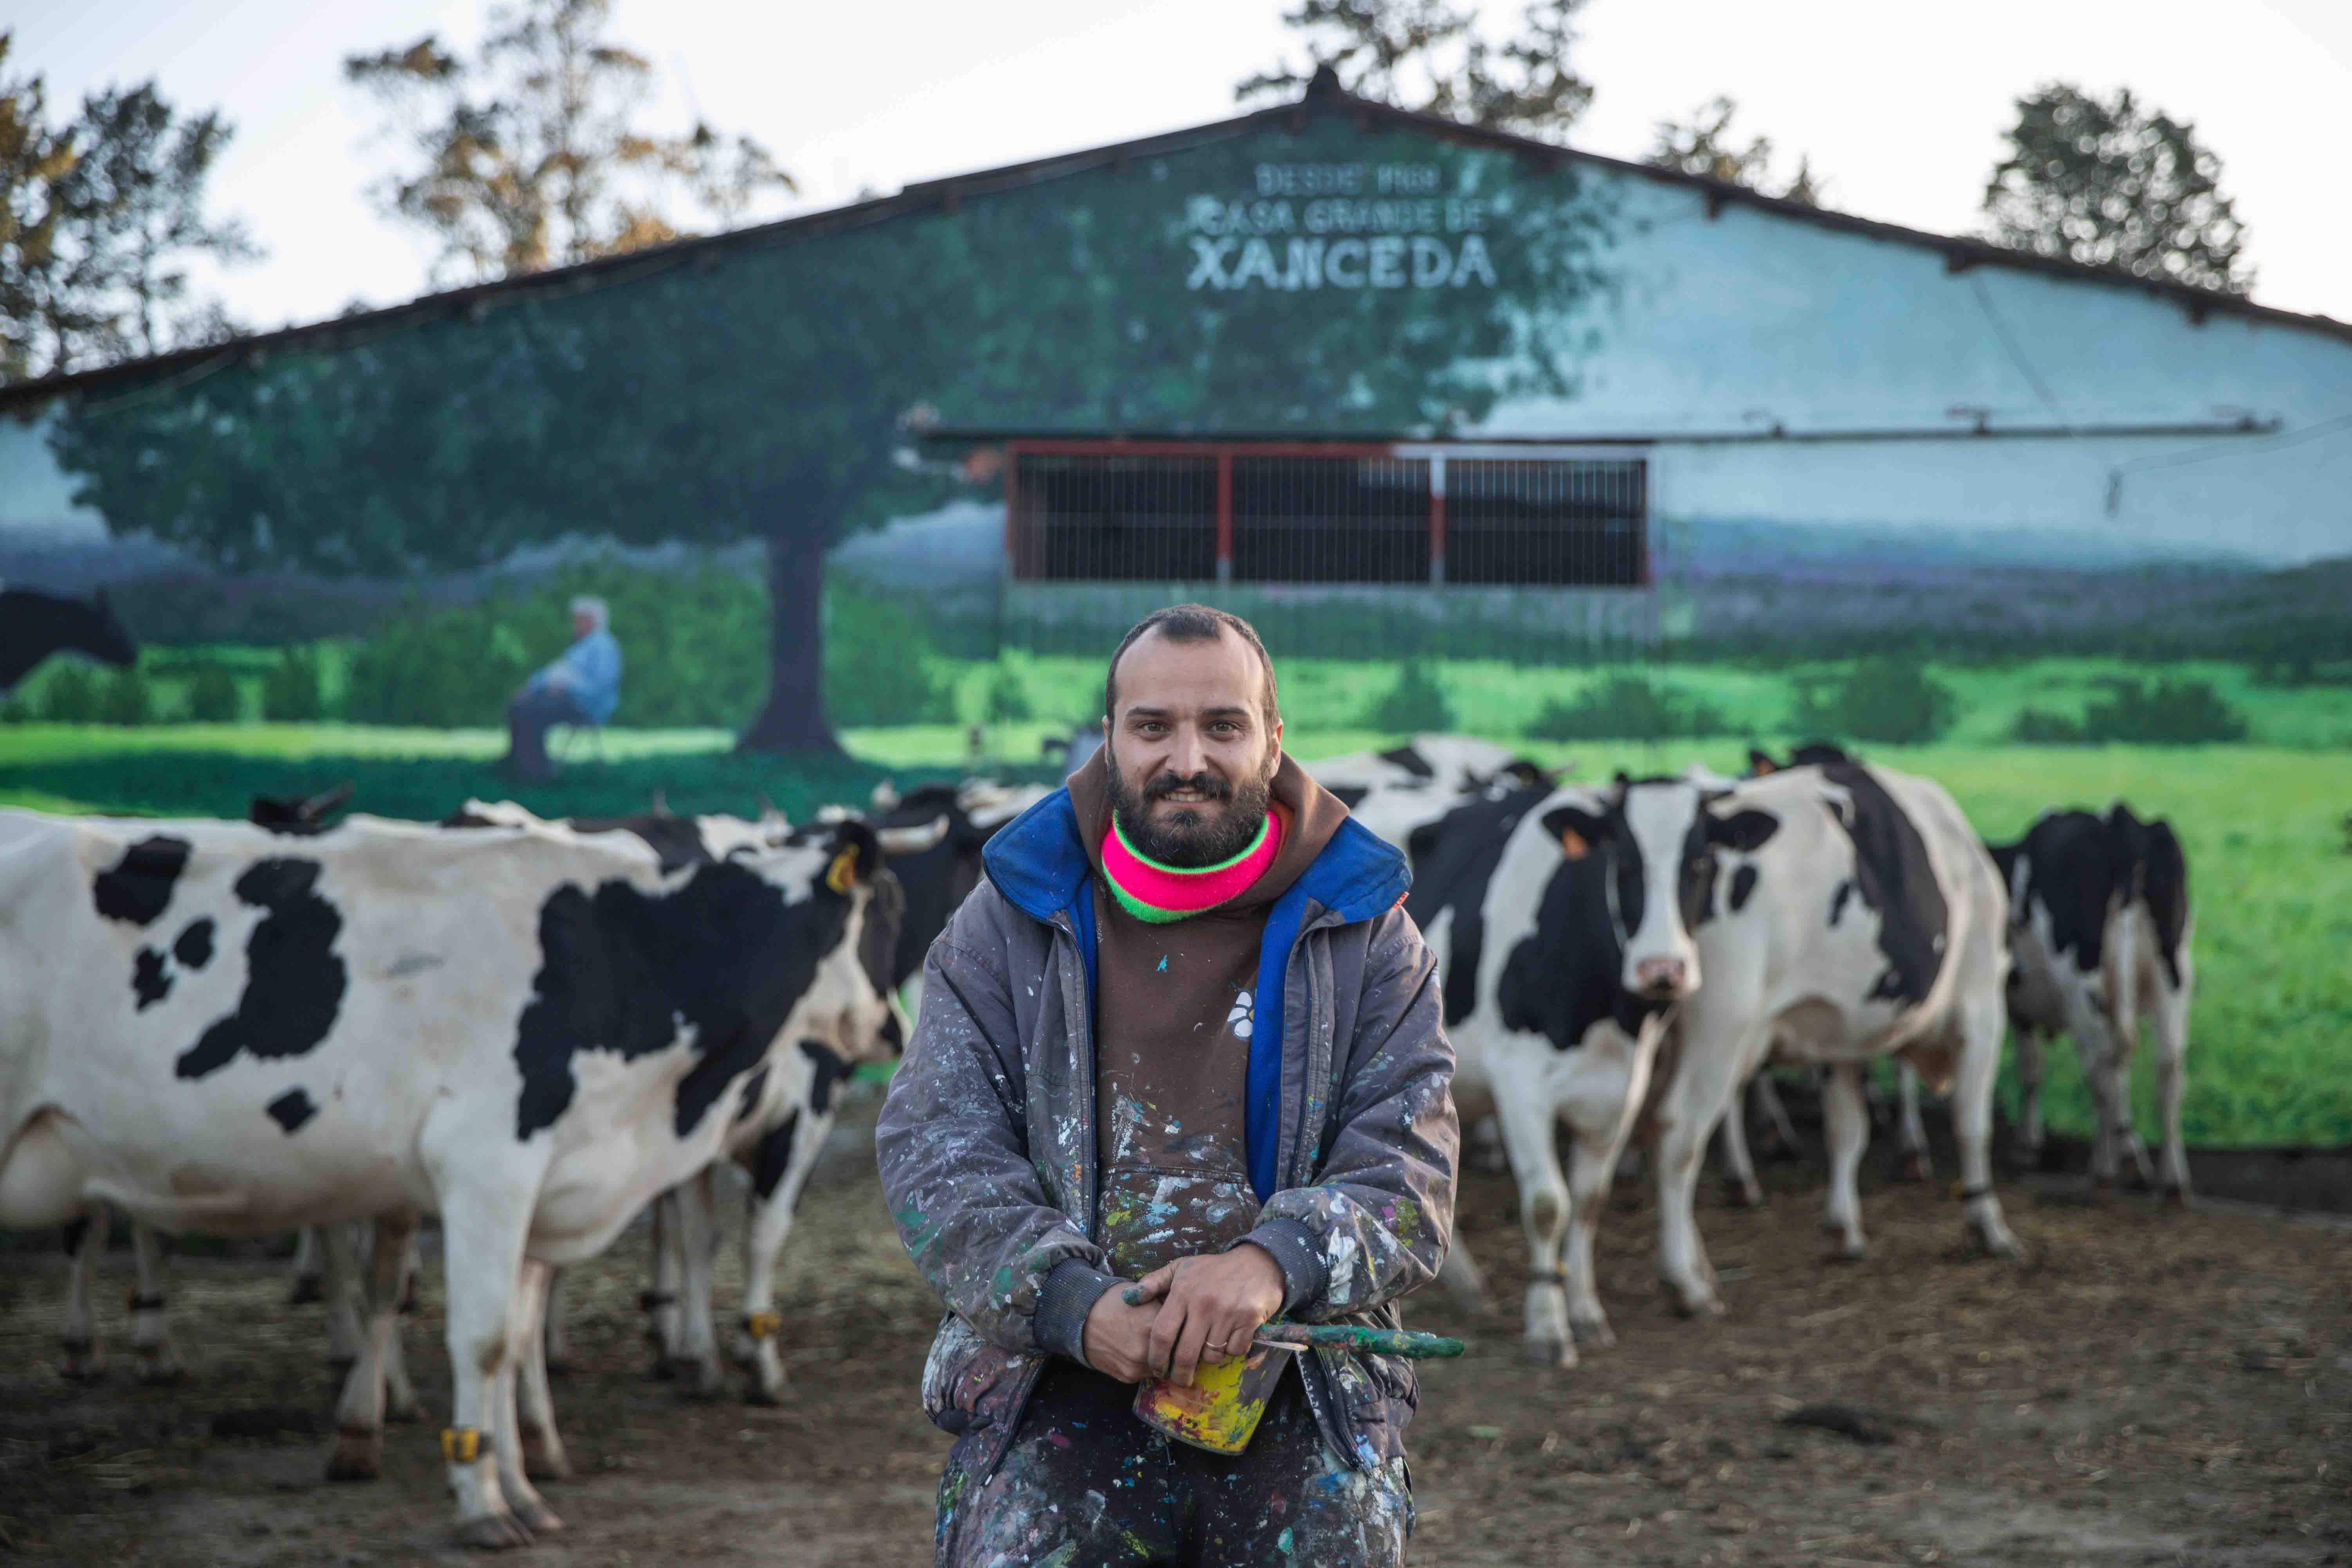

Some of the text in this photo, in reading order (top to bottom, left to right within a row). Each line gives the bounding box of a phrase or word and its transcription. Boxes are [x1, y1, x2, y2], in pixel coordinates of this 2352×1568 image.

[1256, 162, 1364, 196] DESDE
[1303, 198, 1441, 234] GRANDE
[1445, 198, 1490, 233] DE
[1186, 234, 1497, 290] XANCEDA
